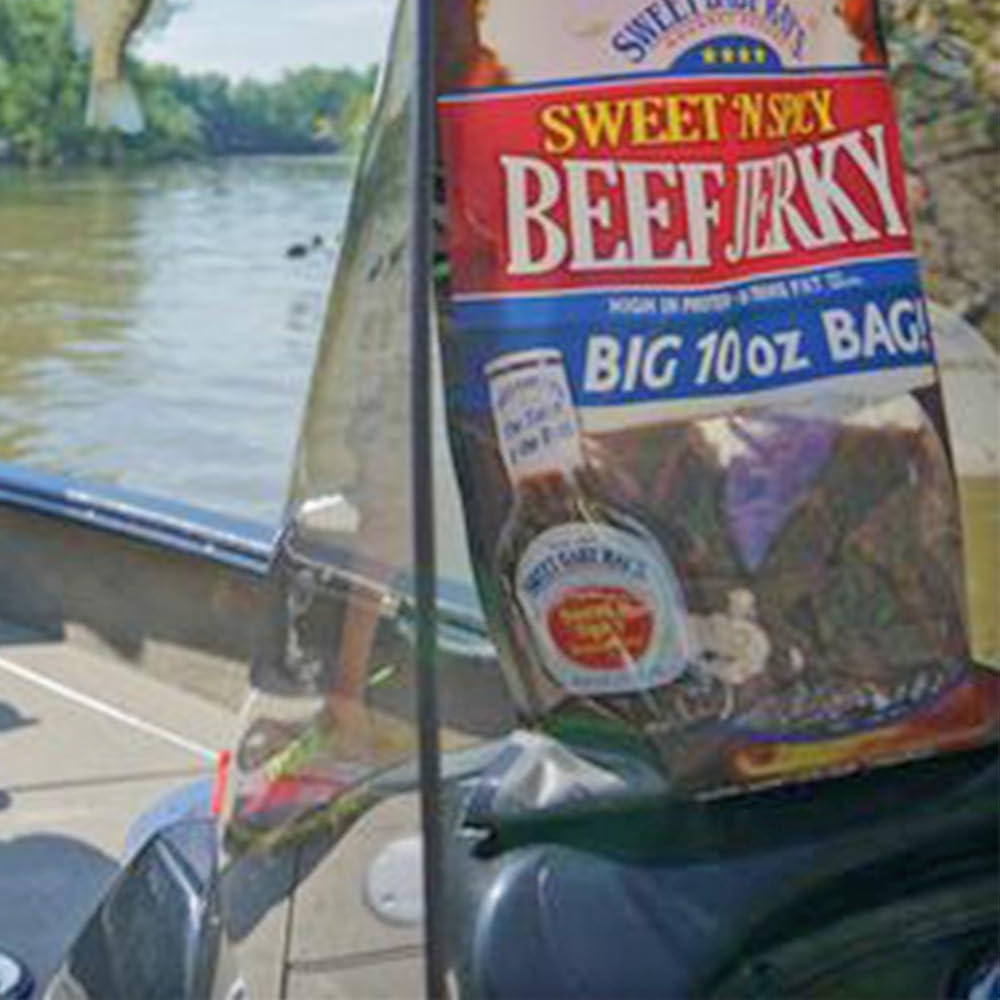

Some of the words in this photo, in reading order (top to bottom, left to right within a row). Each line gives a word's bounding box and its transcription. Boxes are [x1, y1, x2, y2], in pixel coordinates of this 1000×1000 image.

[540, 92, 725, 154] SWEET
[499, 154, 728, 276] BEEF
[726, 124, 909, 263] JERKY
[583, 334, 683, 393] BIG
